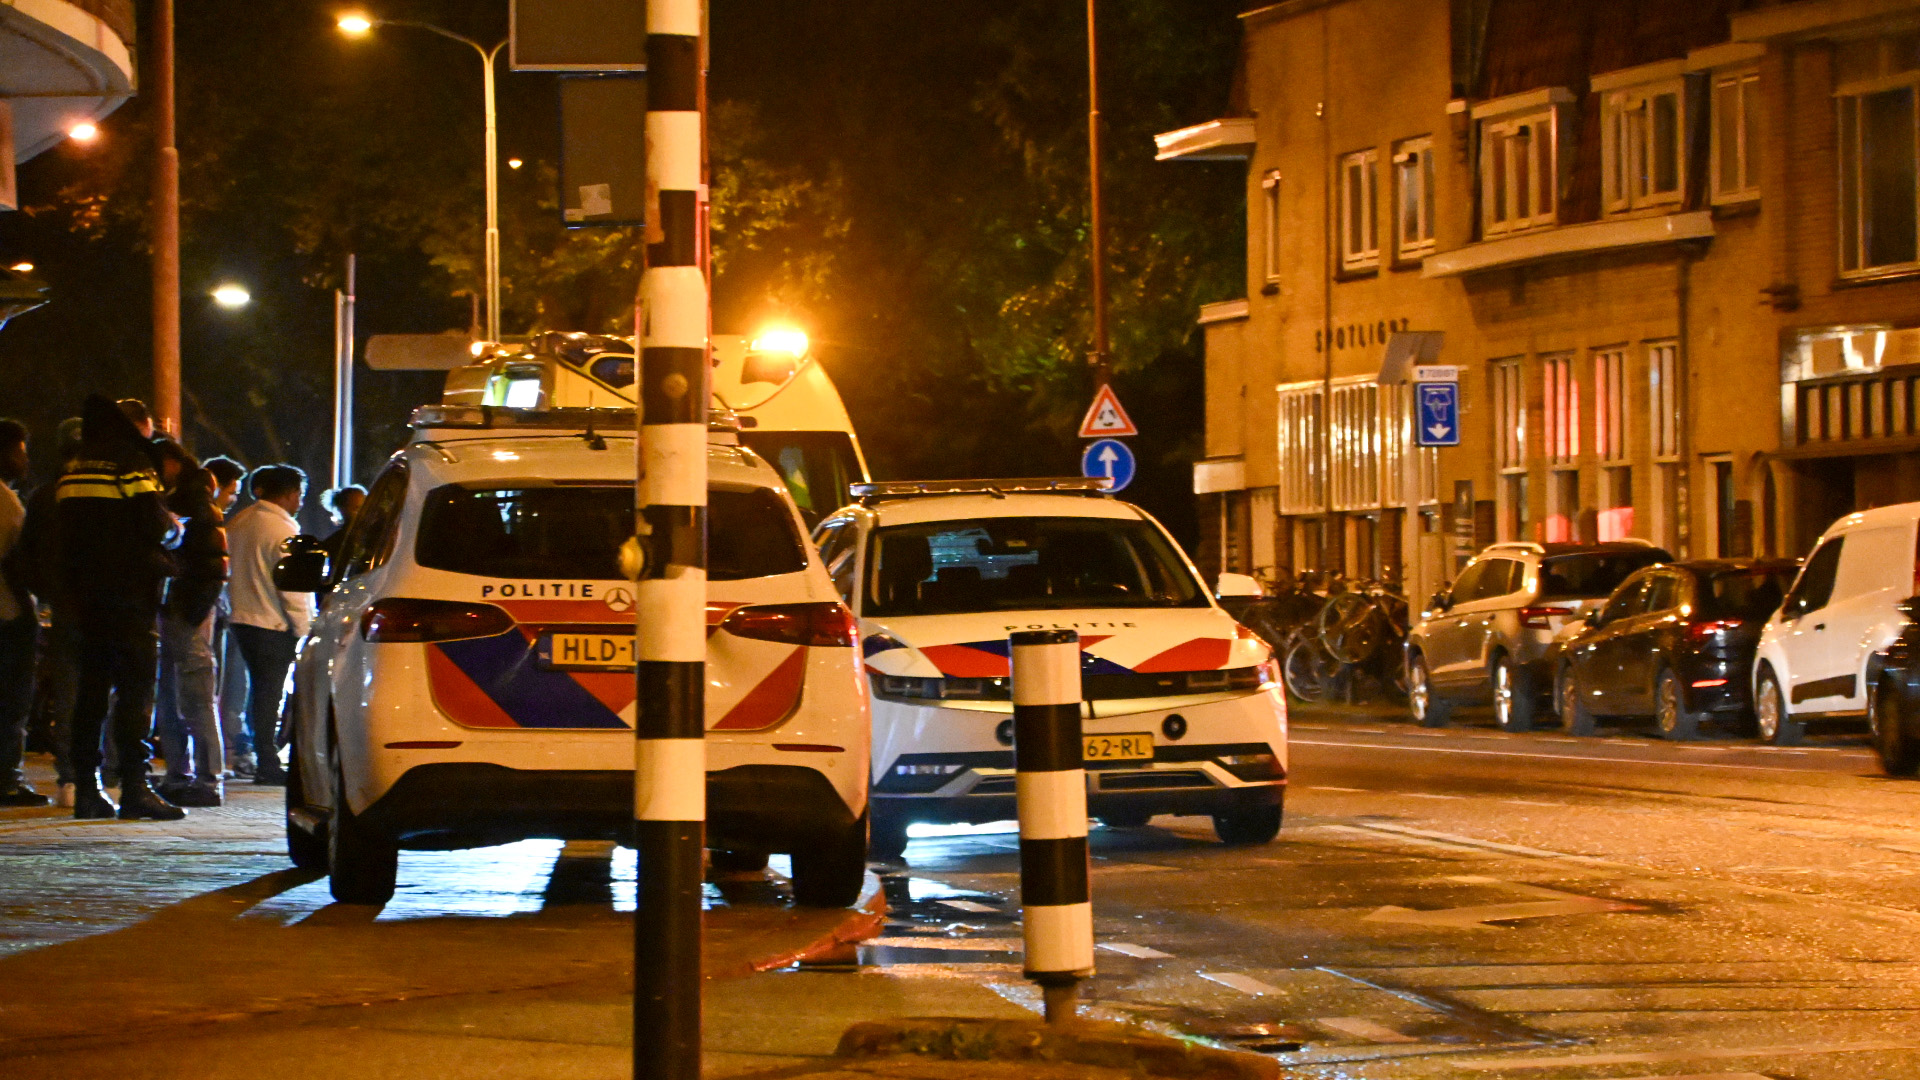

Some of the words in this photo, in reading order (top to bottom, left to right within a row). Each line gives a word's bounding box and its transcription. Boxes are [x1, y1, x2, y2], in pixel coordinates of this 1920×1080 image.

[482, 584, 594, 597] POLITIE
[1004, 622, 1138, 631] POLITIE
[1087, 738, 1146, 757] 62-RL
